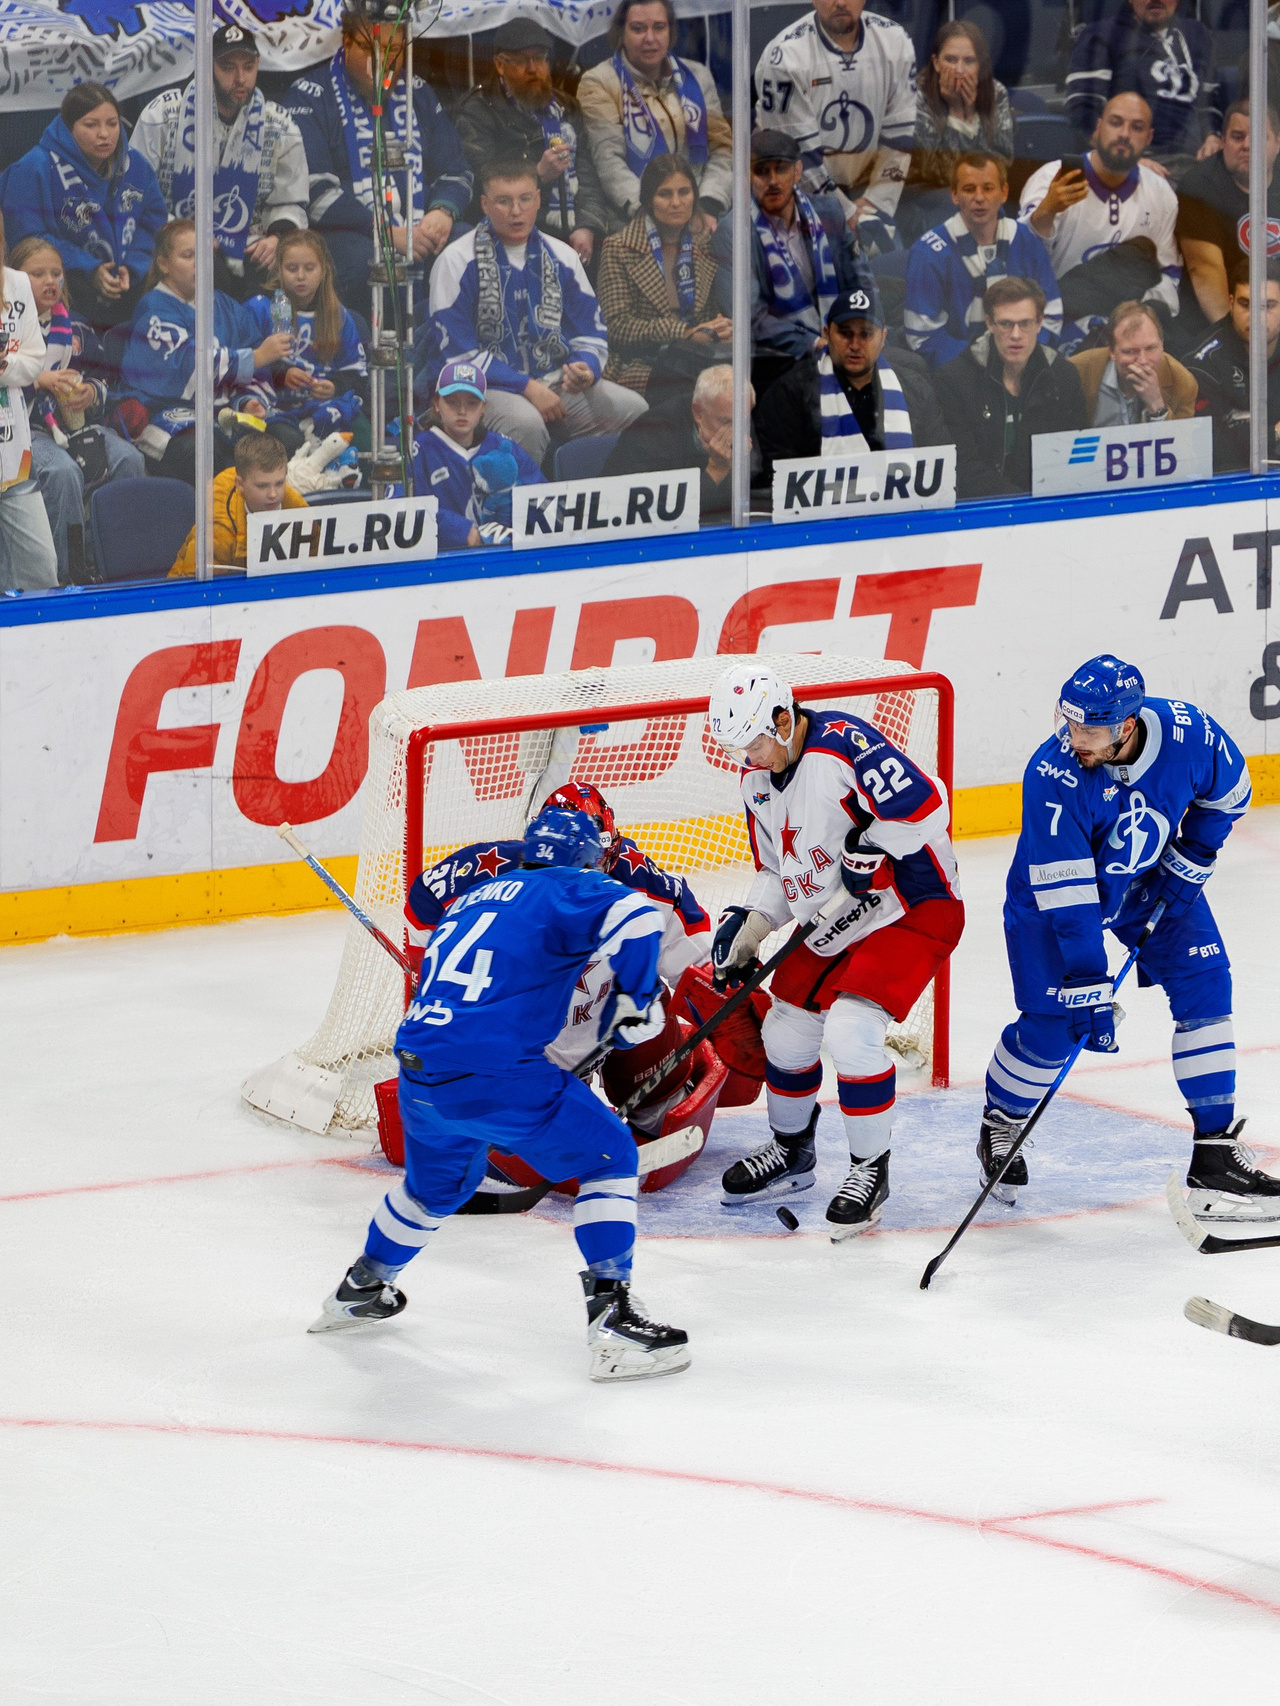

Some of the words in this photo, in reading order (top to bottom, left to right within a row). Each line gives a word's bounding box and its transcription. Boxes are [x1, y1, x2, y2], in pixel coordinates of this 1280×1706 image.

[762, 78, 795, 115] 57
[1105, 436, 1178, 483] ВТБ
[783, 457, 946, 511] KHL.RU
[523, 481, 689, 536] KHL.RU
[258, 508, 427, 563] KHL.RU
[1123, 675, 1139, 690] ВТБ
[1168, 700, 1192, 726] ВТБ
[1217, 734, 1233, 766] 7
[862, 757, 914, 804] 22
[1045, 801, 1063, 836] 7
[535, 843, 555, 861] 34
[842, 855, 878, 871] CM
[781, 844, 835, 903] СКА
[1036, 867, 1079, 883] Москва
[813, 893, 882, 948] СНЕФТЬ
[1200, 943, 1220, 958] ВТБ
